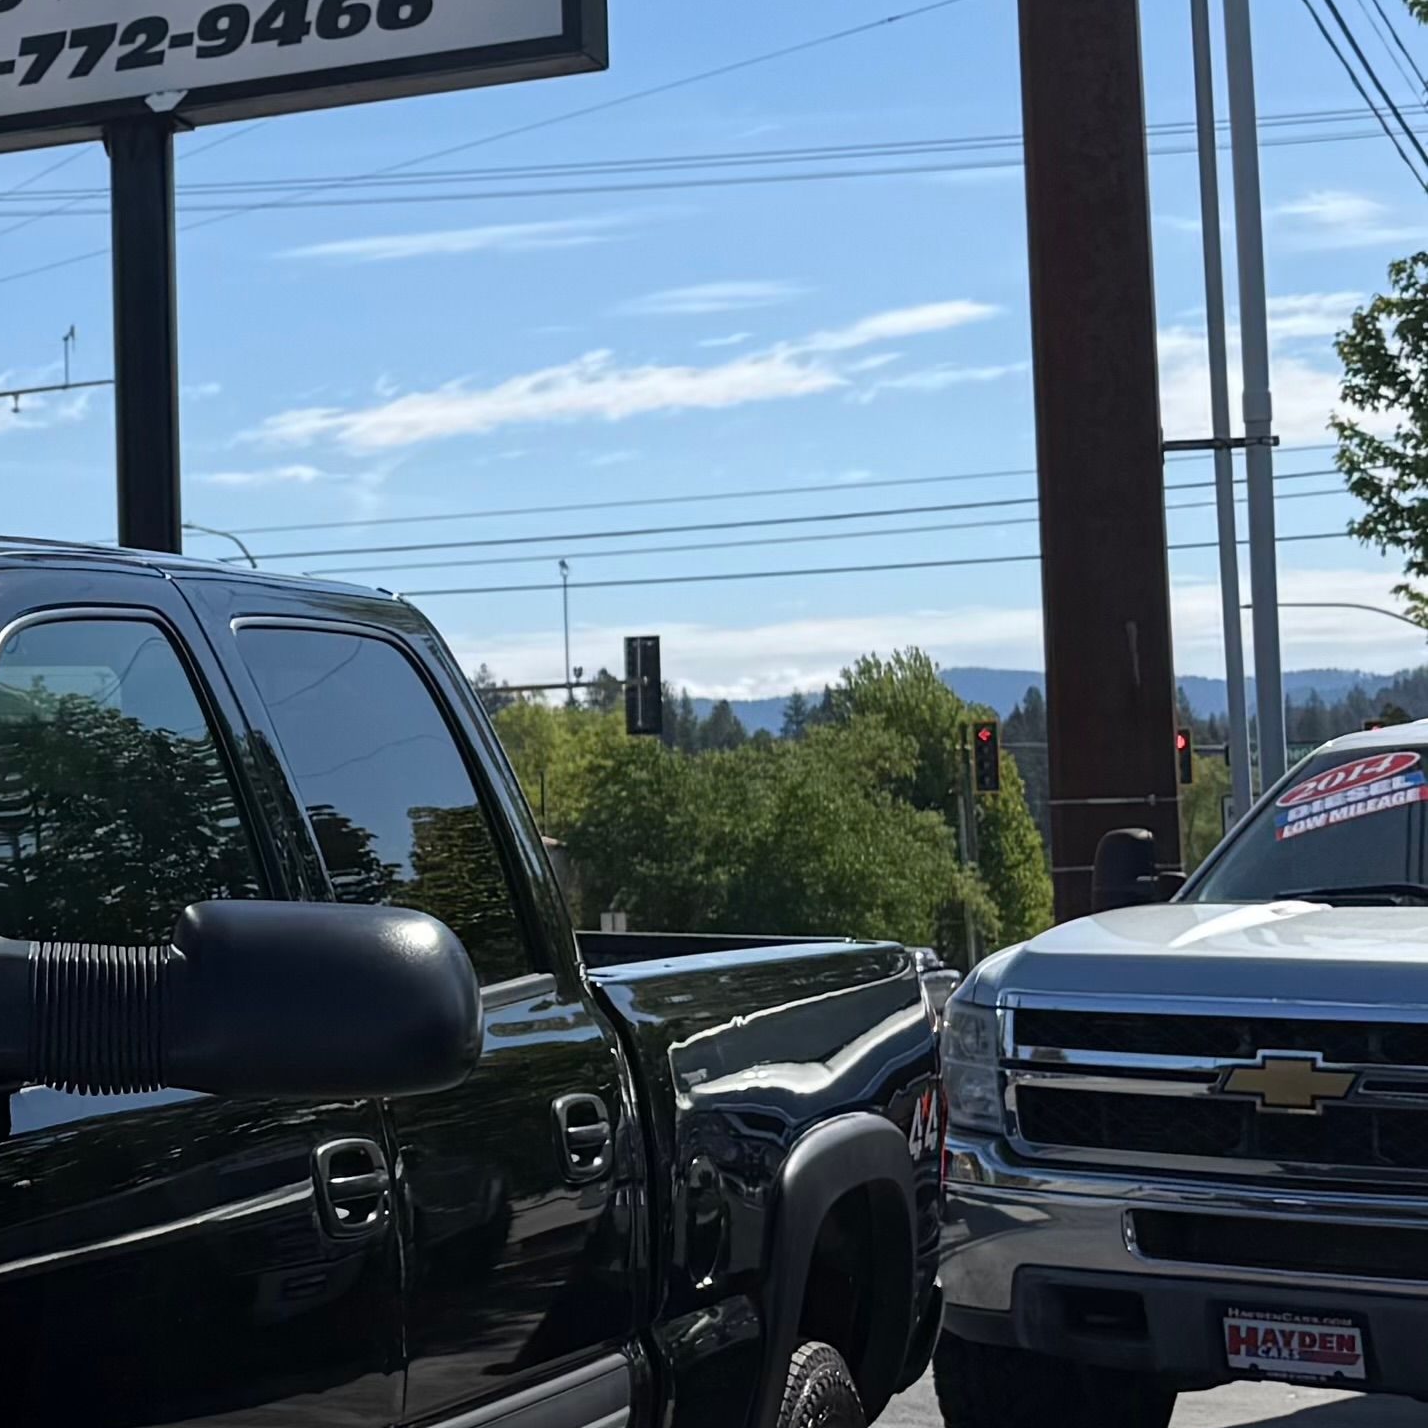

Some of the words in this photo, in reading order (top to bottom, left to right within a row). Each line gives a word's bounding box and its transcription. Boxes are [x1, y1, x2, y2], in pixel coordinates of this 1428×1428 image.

[1287, 774, 1415, 822] DIESEL
[1294, 755, 1396, 801] 2014
[1282, 812, 1328, 839] LOW
[1329, 786, 1420, 824] MILEAGE
[1227, 1324, 1357, 1356] HAYDEN
